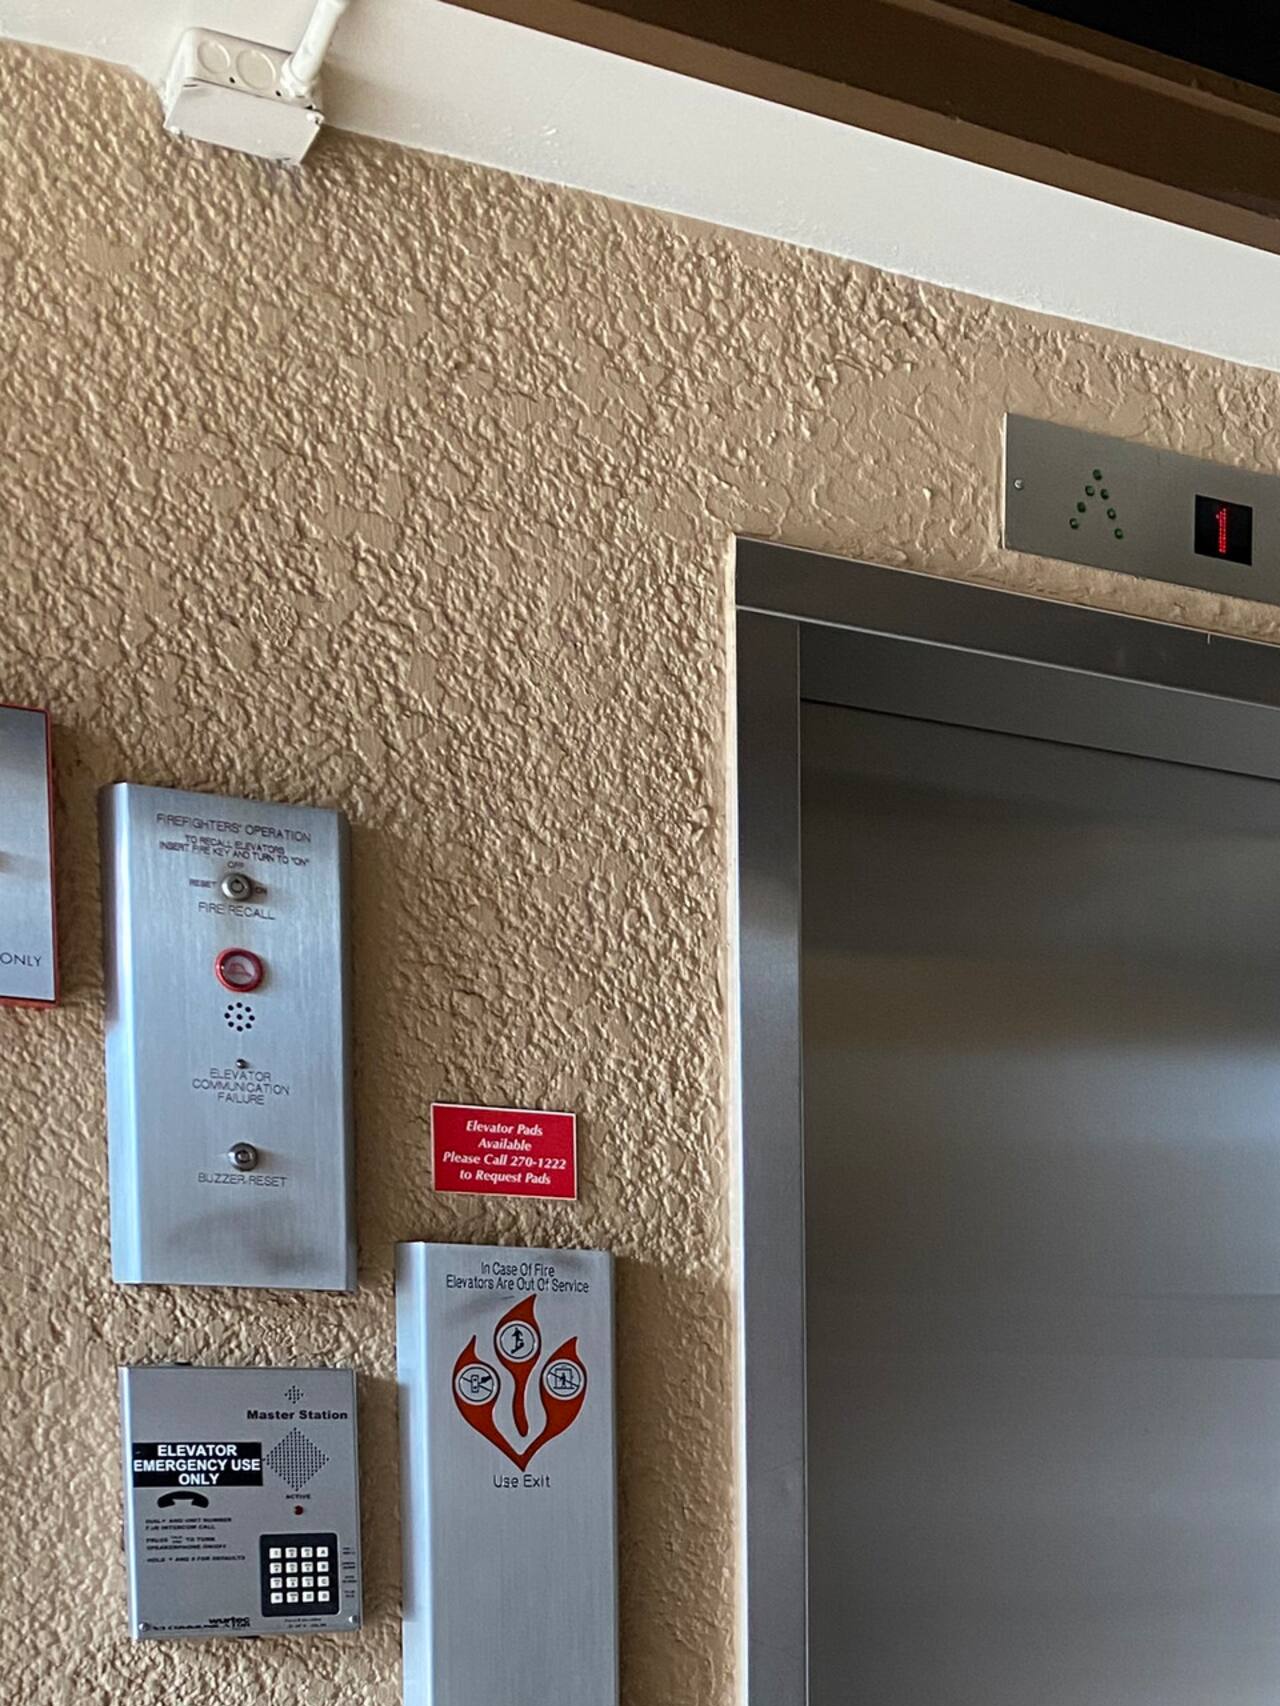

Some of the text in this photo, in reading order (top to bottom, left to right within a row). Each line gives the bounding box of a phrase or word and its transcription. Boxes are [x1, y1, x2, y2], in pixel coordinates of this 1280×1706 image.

[1215, 507, 1227, 554] 1
[185, 834, 197, 844] TO
[200, 836, 233, 849] RECALL
[245, 825, 312, 843] OPERATION
[159, 841, 190, 852] INSERT
[192, 845, 210, 856] FIRE
[213, 848, 230, 857] KEY
[232, 850, 250, 860] AND
[252, 852, 275, 863] TURN
[277, 855, 289, 865] TO
[198, 902, 276, 921] FIRE RECALL
[0, 952, 42, 967] ONLY
[210, 1068, 271, 1081] ELEVATOR
[192, 1078, 289, 1096] COMMUNICATION
[218, 1092, 265, 1105] FAILURE
[466, 1120, 543, 1136] Elevator Pads
[478, 1138, 532, 1151] Available
[443, 1151, 567, 1170] Please Call 270-1222
[198, 1172, 287, 1187] BUZZER RESET
[459, 1169, 551, 1185] to Request Pads
[481, 1262, 555, 1277] In Case Of Fire
[446, 1274, 589, 1293] Elevators Are Out Of Service
[247, 1410, 348, 1420] Master Station
[157, 1444, 238, 1457] ELEVATOR
[134, 1458, 261, 1472] EMERGENCY USE
[178, 1473, 220, 1485] ONLY
[493, 1474, 551, 1488] Use Exit
